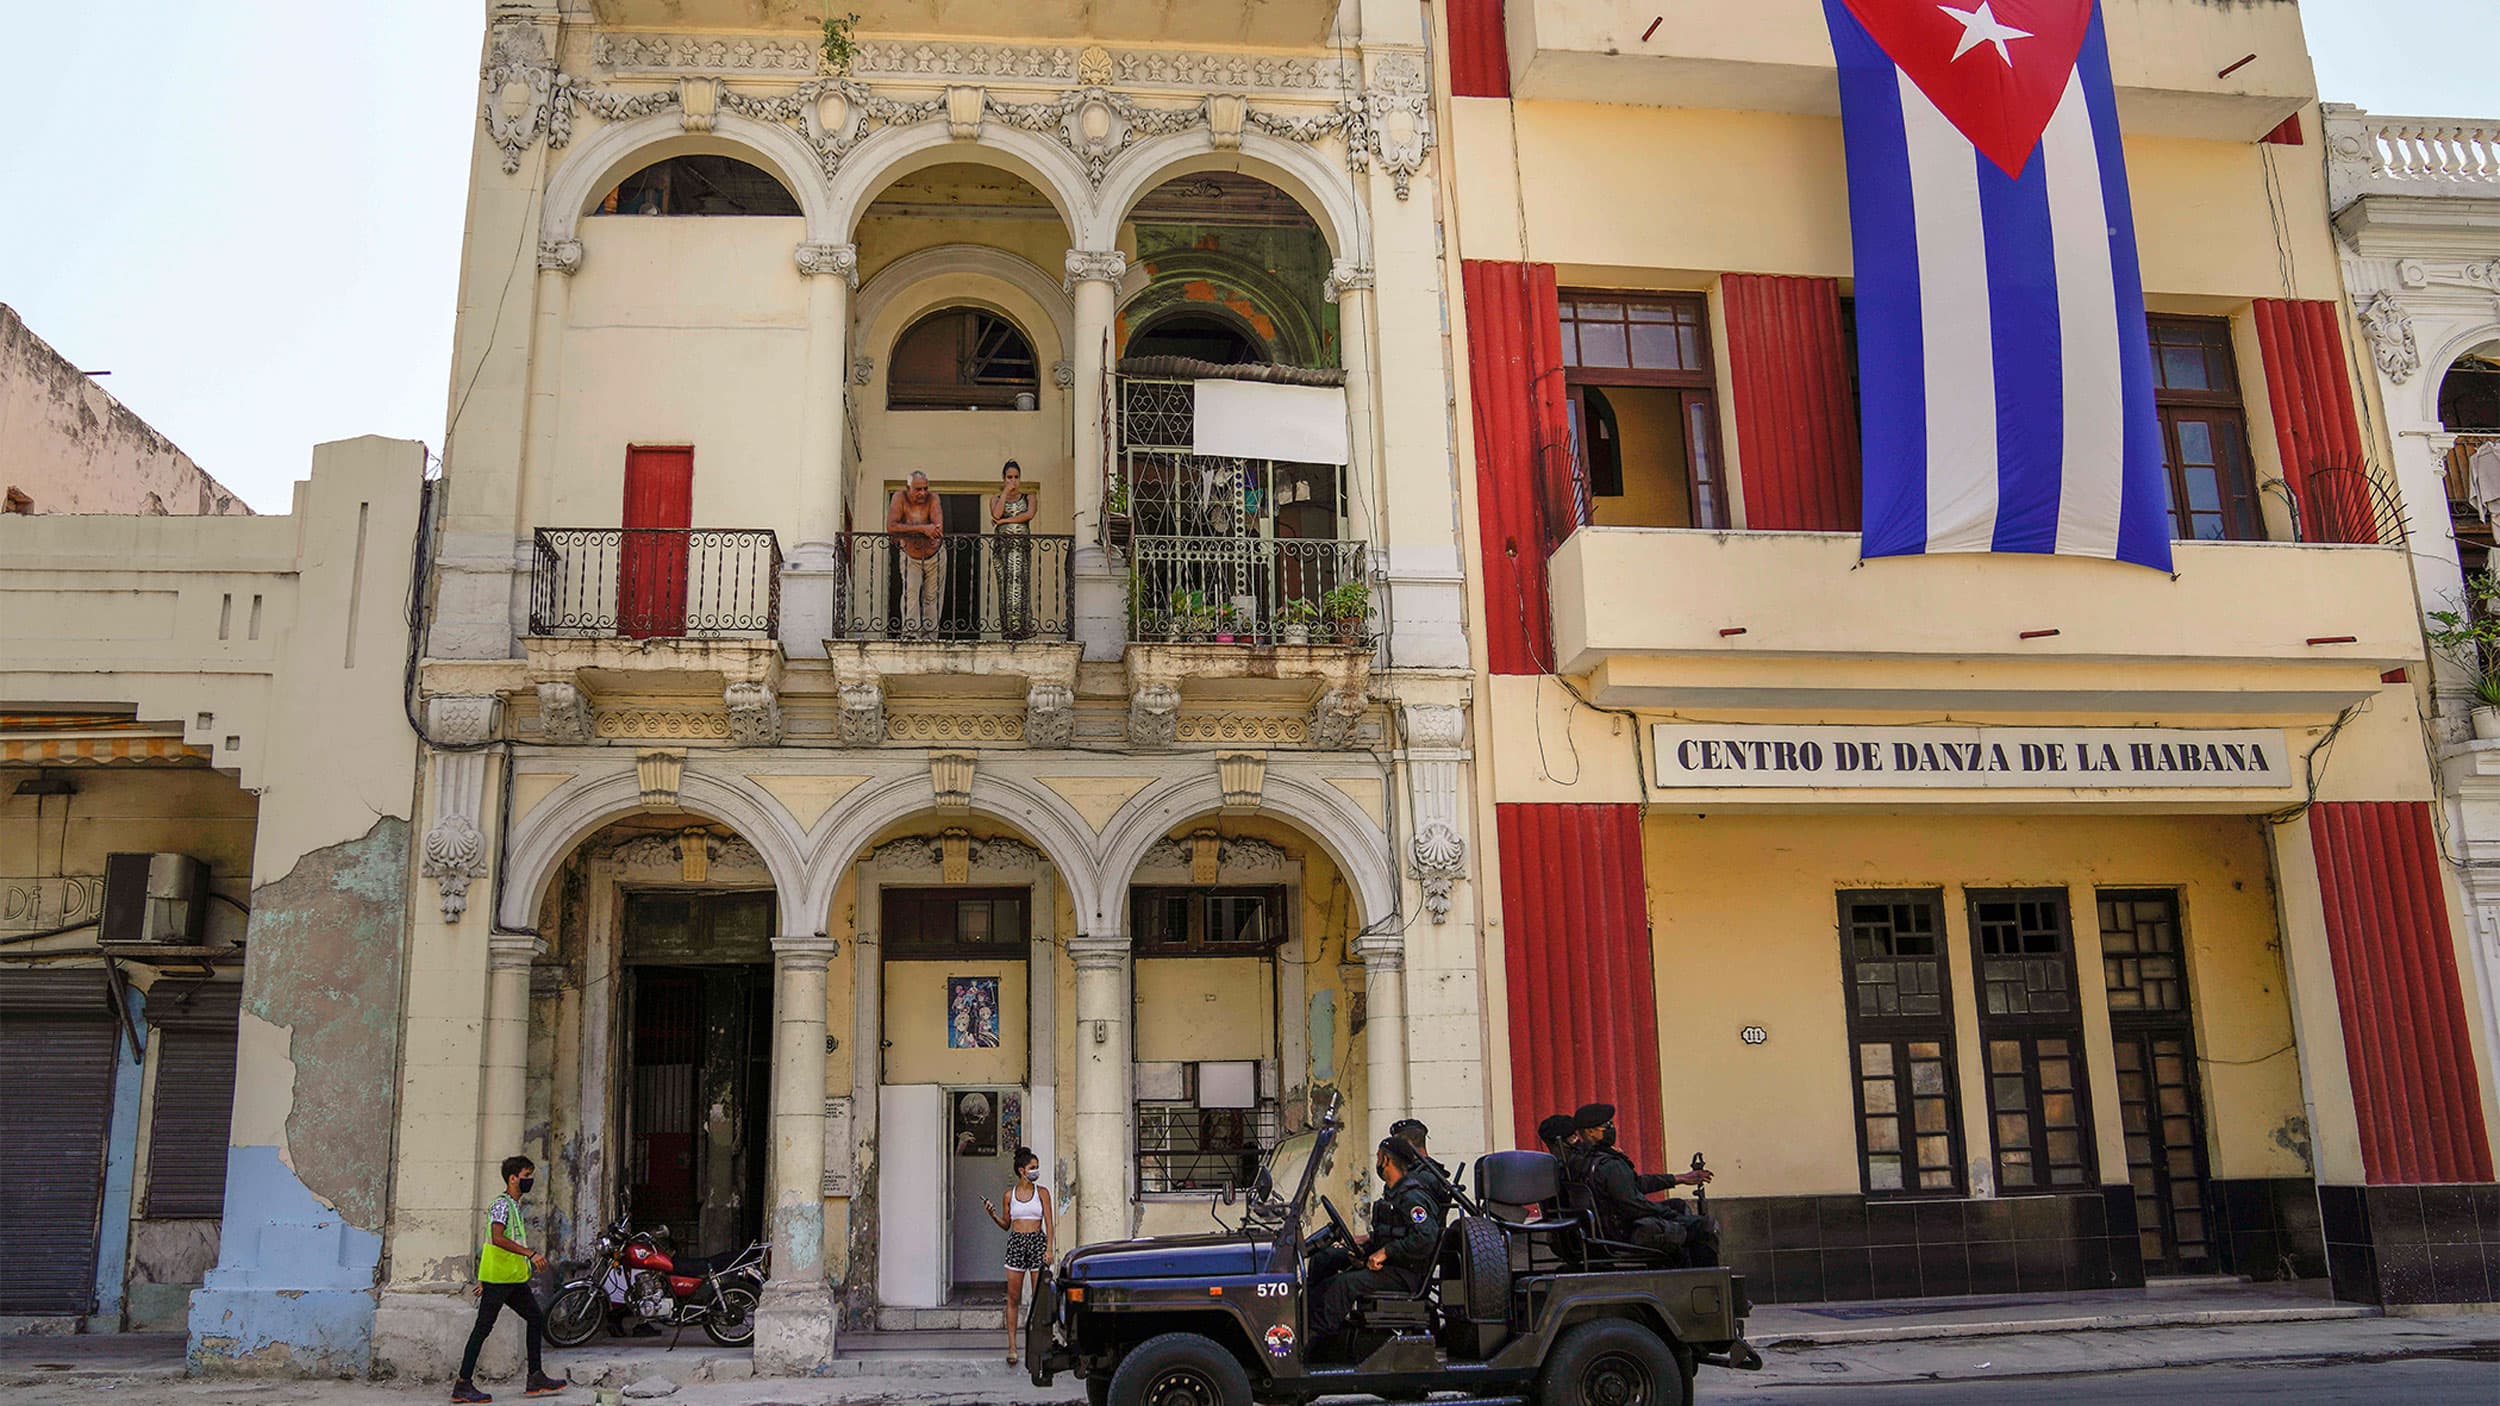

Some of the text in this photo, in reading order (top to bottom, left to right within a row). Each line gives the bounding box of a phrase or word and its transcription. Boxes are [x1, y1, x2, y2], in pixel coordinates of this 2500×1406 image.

[1677, 739, 2270, 772] CENTRO DE DANZA DE LA HABANA
[1257, 1282, 1289, 1297] 570
